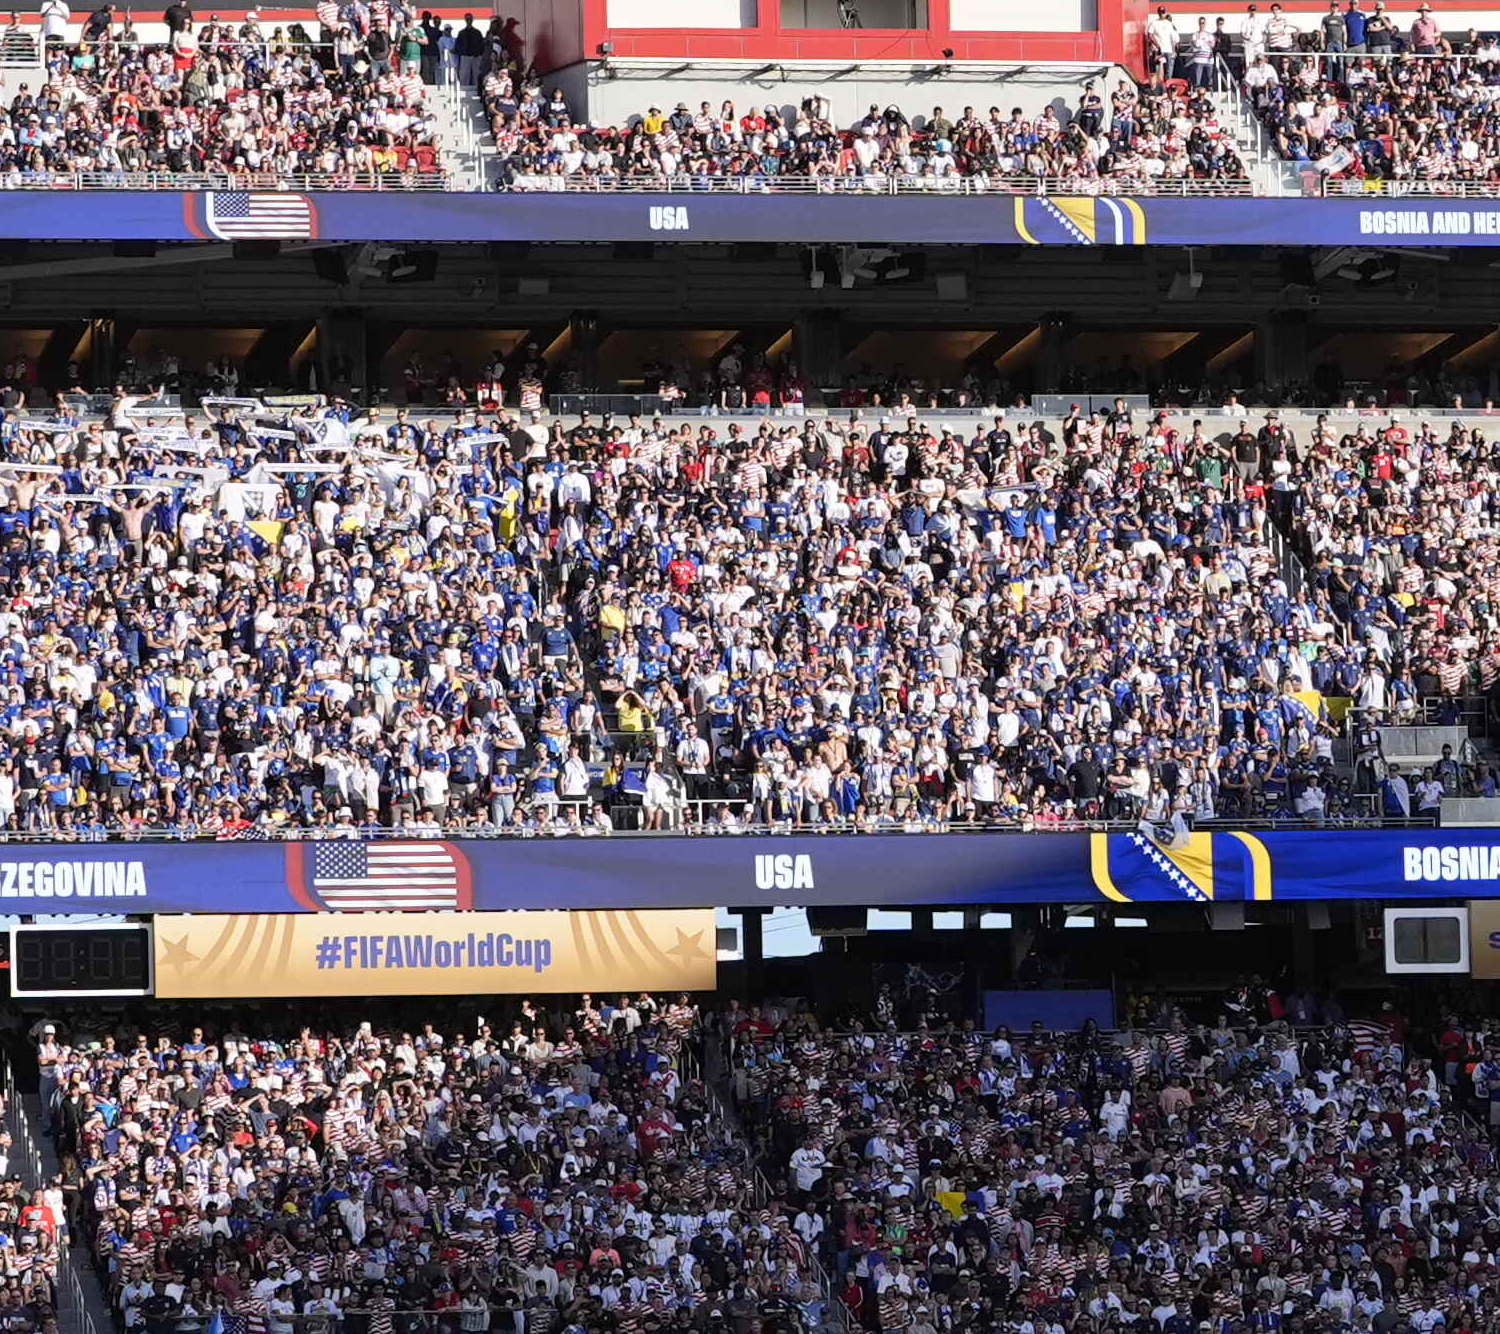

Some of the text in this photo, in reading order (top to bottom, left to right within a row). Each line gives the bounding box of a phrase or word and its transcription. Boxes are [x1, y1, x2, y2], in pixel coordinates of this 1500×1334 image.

[649, 206, 689, 231] USA
[1360, 210, 1430, 236] BOSNIA
[1432, 211, 1472, 236] AND
[756, 855, 815, 891] USA
[315, 932, 553, 975] #FIFAWorldCup
